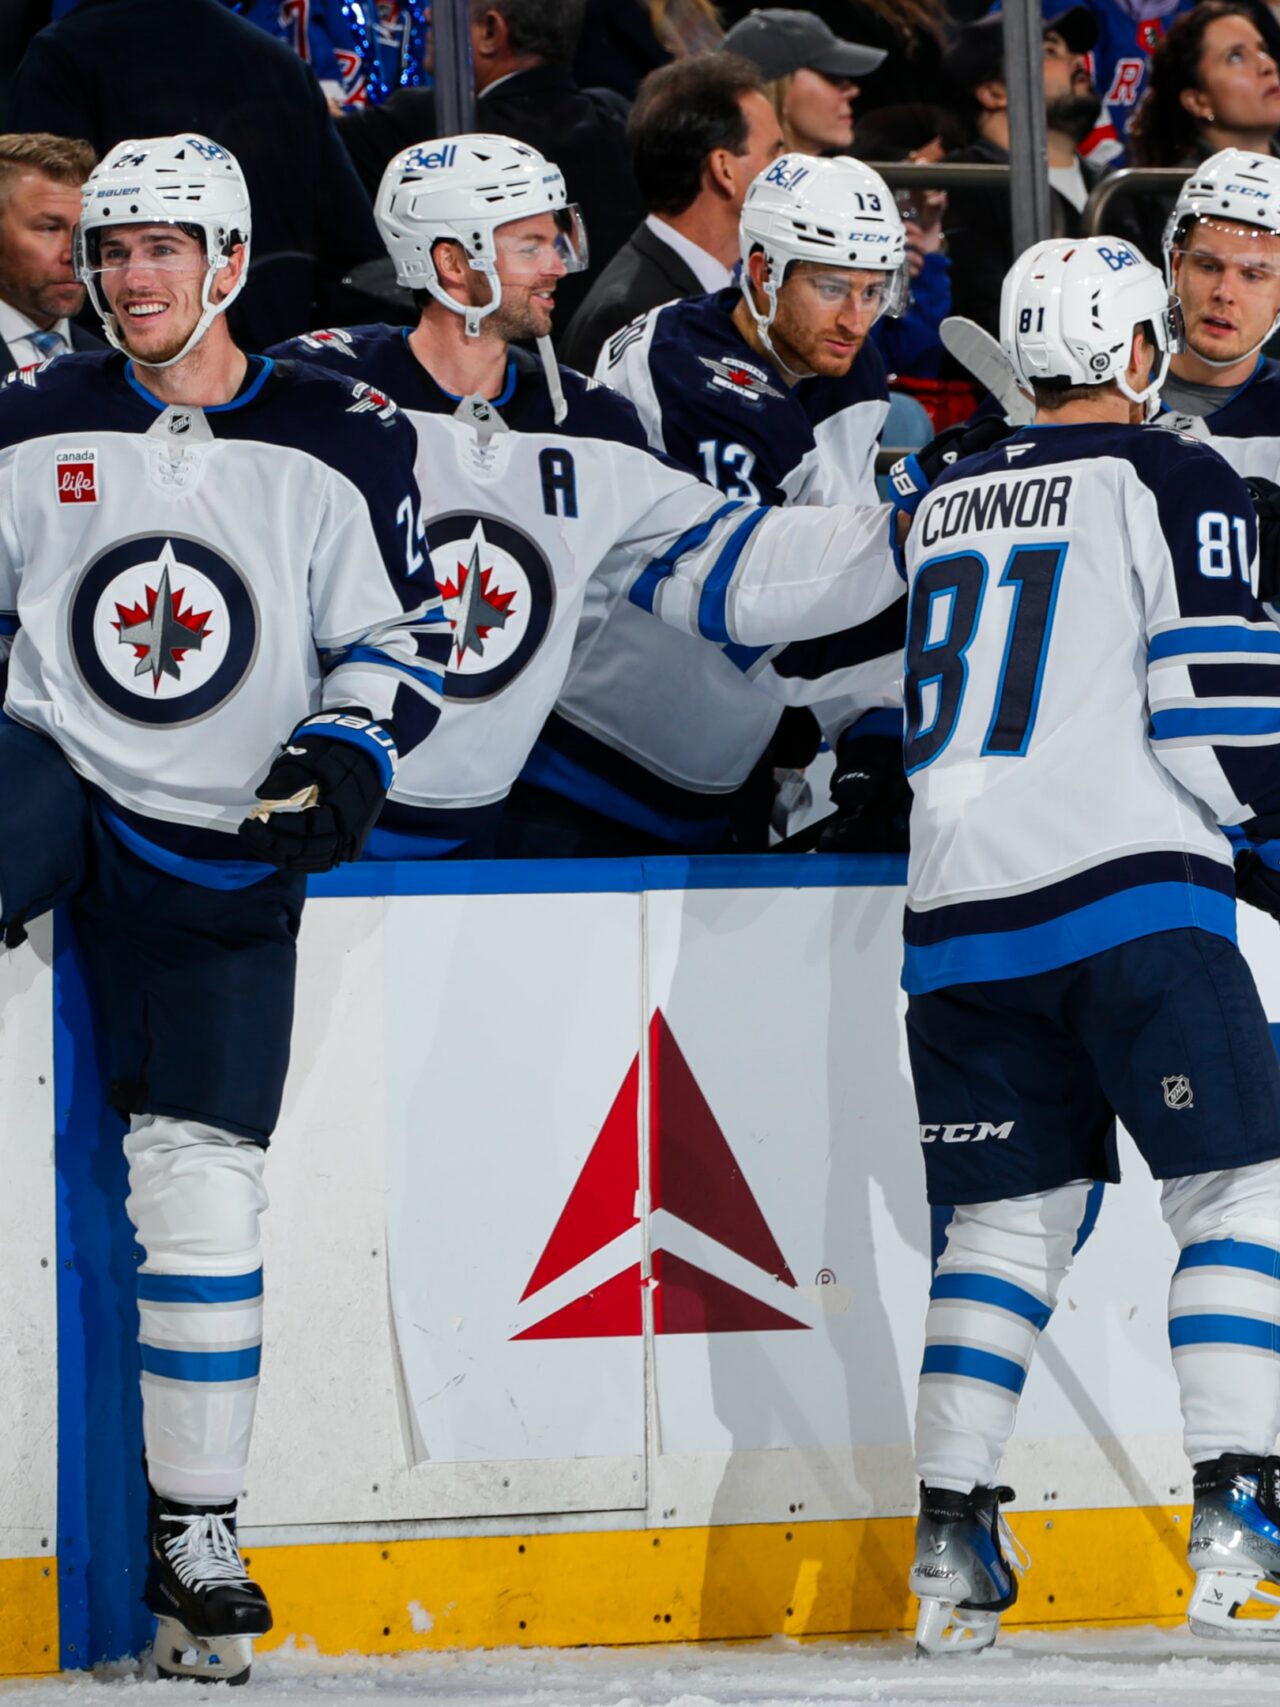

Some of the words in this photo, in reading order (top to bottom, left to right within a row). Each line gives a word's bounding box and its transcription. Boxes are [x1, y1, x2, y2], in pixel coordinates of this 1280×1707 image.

[1104, 57, 1145, 106] R
[112, 153, 149, 170] 24
[404, 144, 458, 173] Bell
[765, 159, 809, 191] Bell
[96, 186, 141, 198] BAUER
[853, 192, 882, 213] 13
[1223, 183, 1272, 200] CCM
[848, 231, 891, 244] CCM
[1096, 241, 1142, 272] Bell
[1018, 306, 1046, 334] 81
[56, 450, 95, 462] canada
[58, 470, 95, 499] life
[538, 447, 578, 519] A
[698, 439, 761, 506] 13
[921, 475, 1073, 548] CONNOR
[1196, 510, 1251, 585] 81
[902, 541, 1070, 778] 81
[919, 1120, 1016, 1144] CCM
